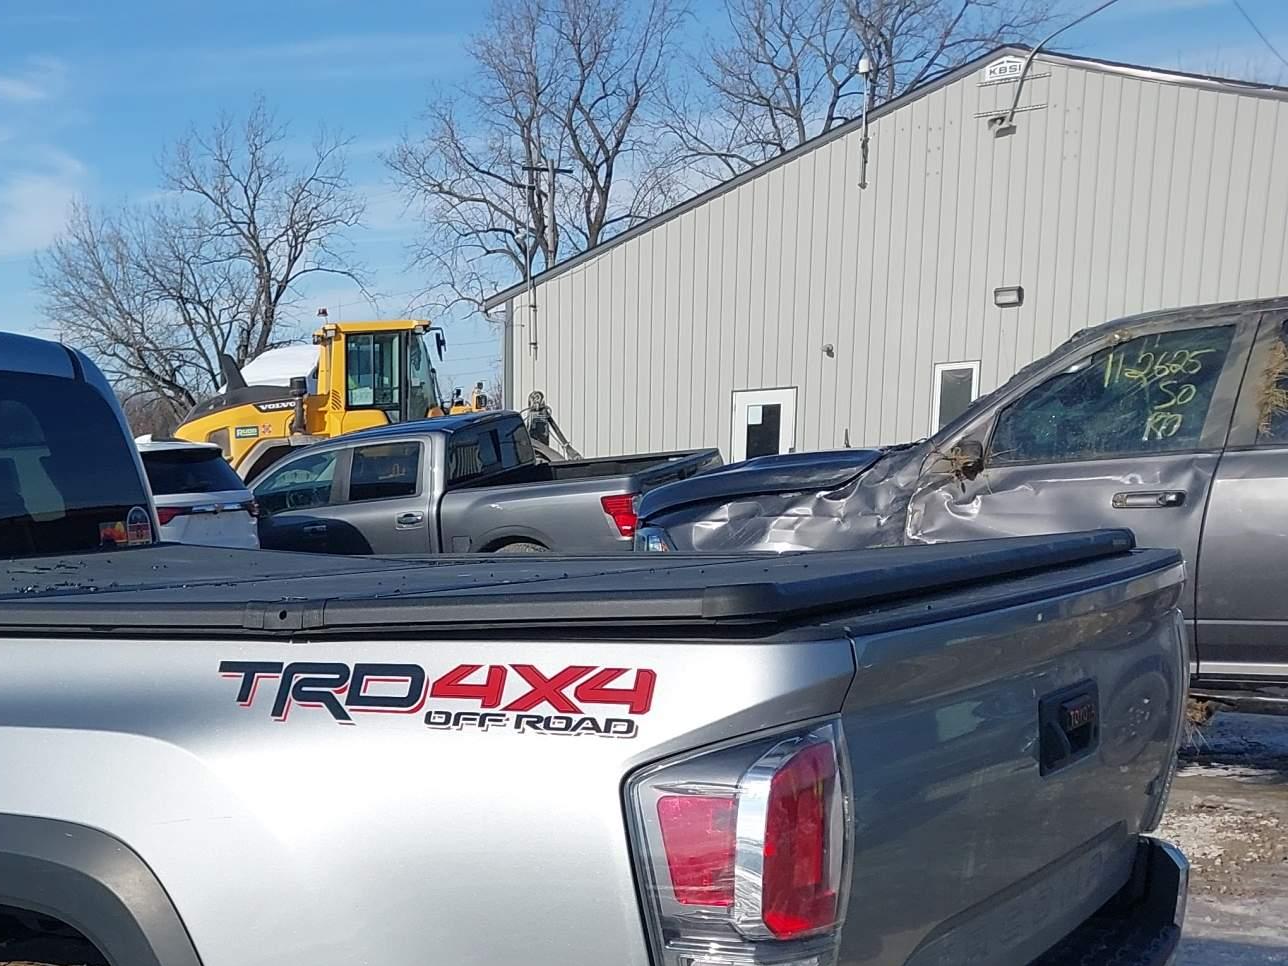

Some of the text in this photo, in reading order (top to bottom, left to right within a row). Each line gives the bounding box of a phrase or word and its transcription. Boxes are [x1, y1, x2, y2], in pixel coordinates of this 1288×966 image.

[989, 64, 1022, 75] KBSI
[258, 401, 296, 410] VOLVO
[219, 661, 430, 726] TRD
[423, 710, 639, 739] OFF ROAD
